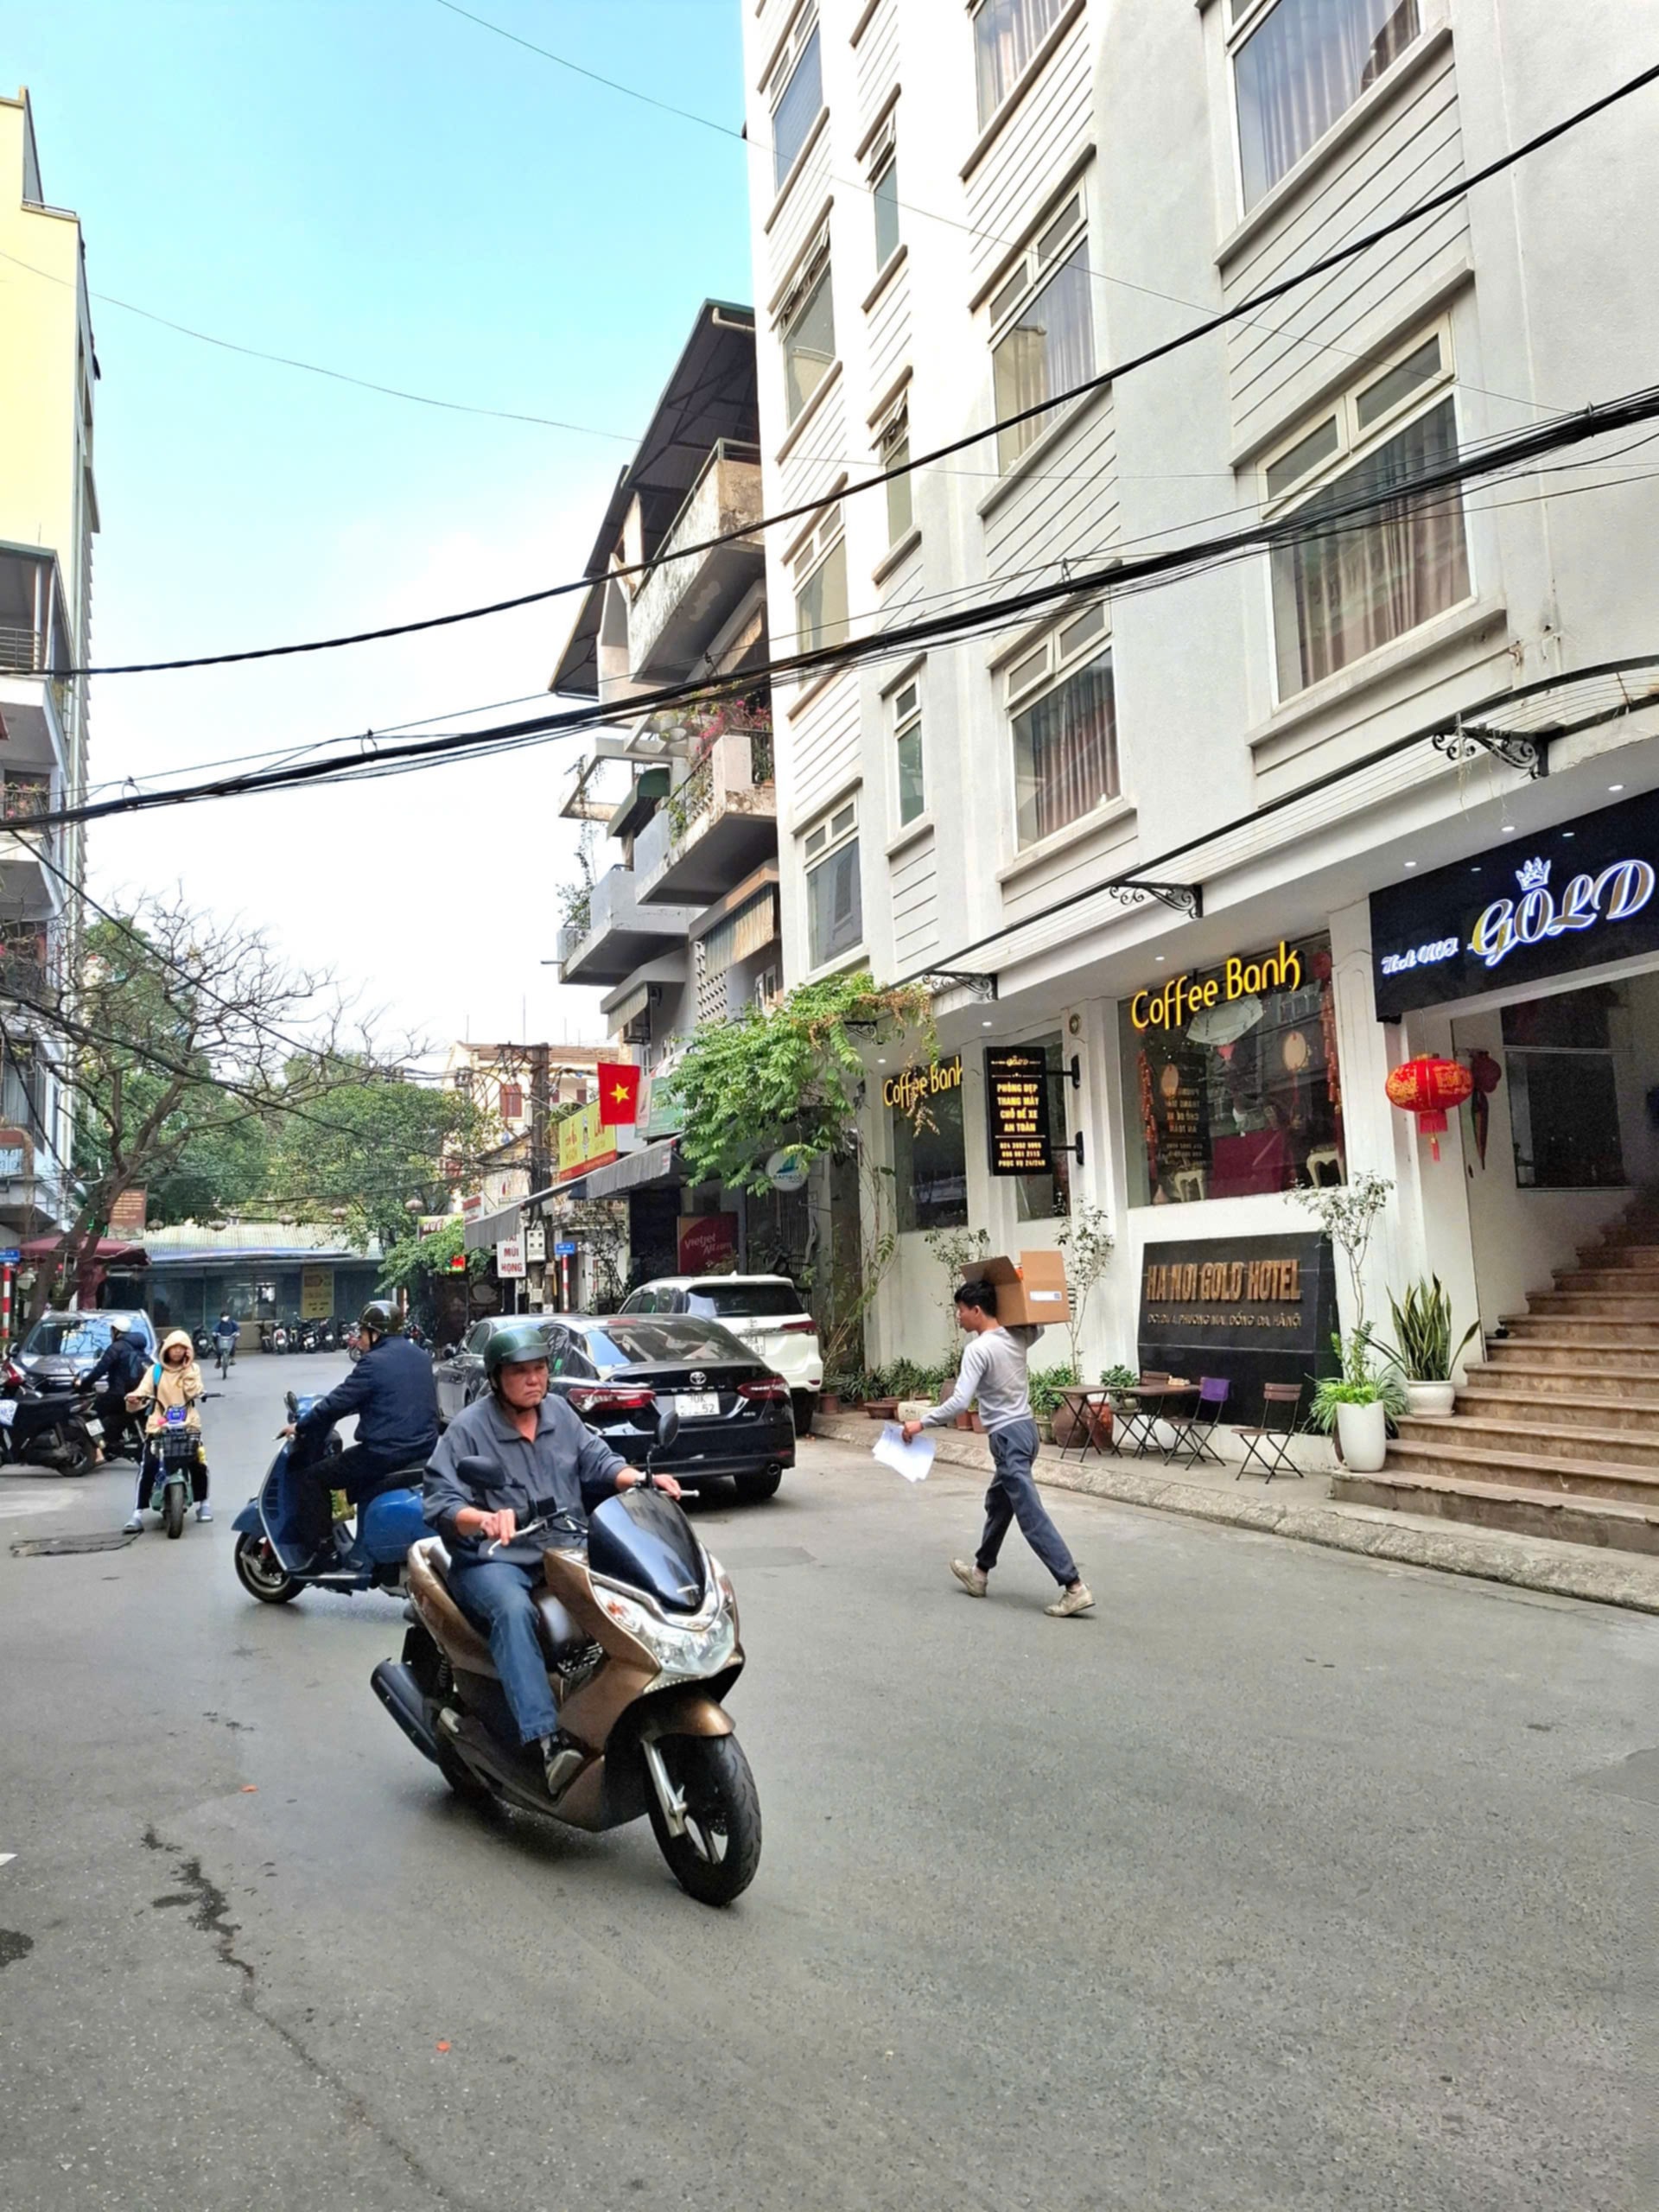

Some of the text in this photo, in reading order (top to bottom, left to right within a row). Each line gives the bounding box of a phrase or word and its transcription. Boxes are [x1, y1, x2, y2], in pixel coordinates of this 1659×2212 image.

[1467, 859, 1656, 967] GOLD
[1131, 940, 1301, 1031] Coffee Bank
[883, 1071, 928, 1109] Coffee
[1199, 1261, 1244, 1300] GOLD
[1246, 1258, 1302, 1300] HOTEL
